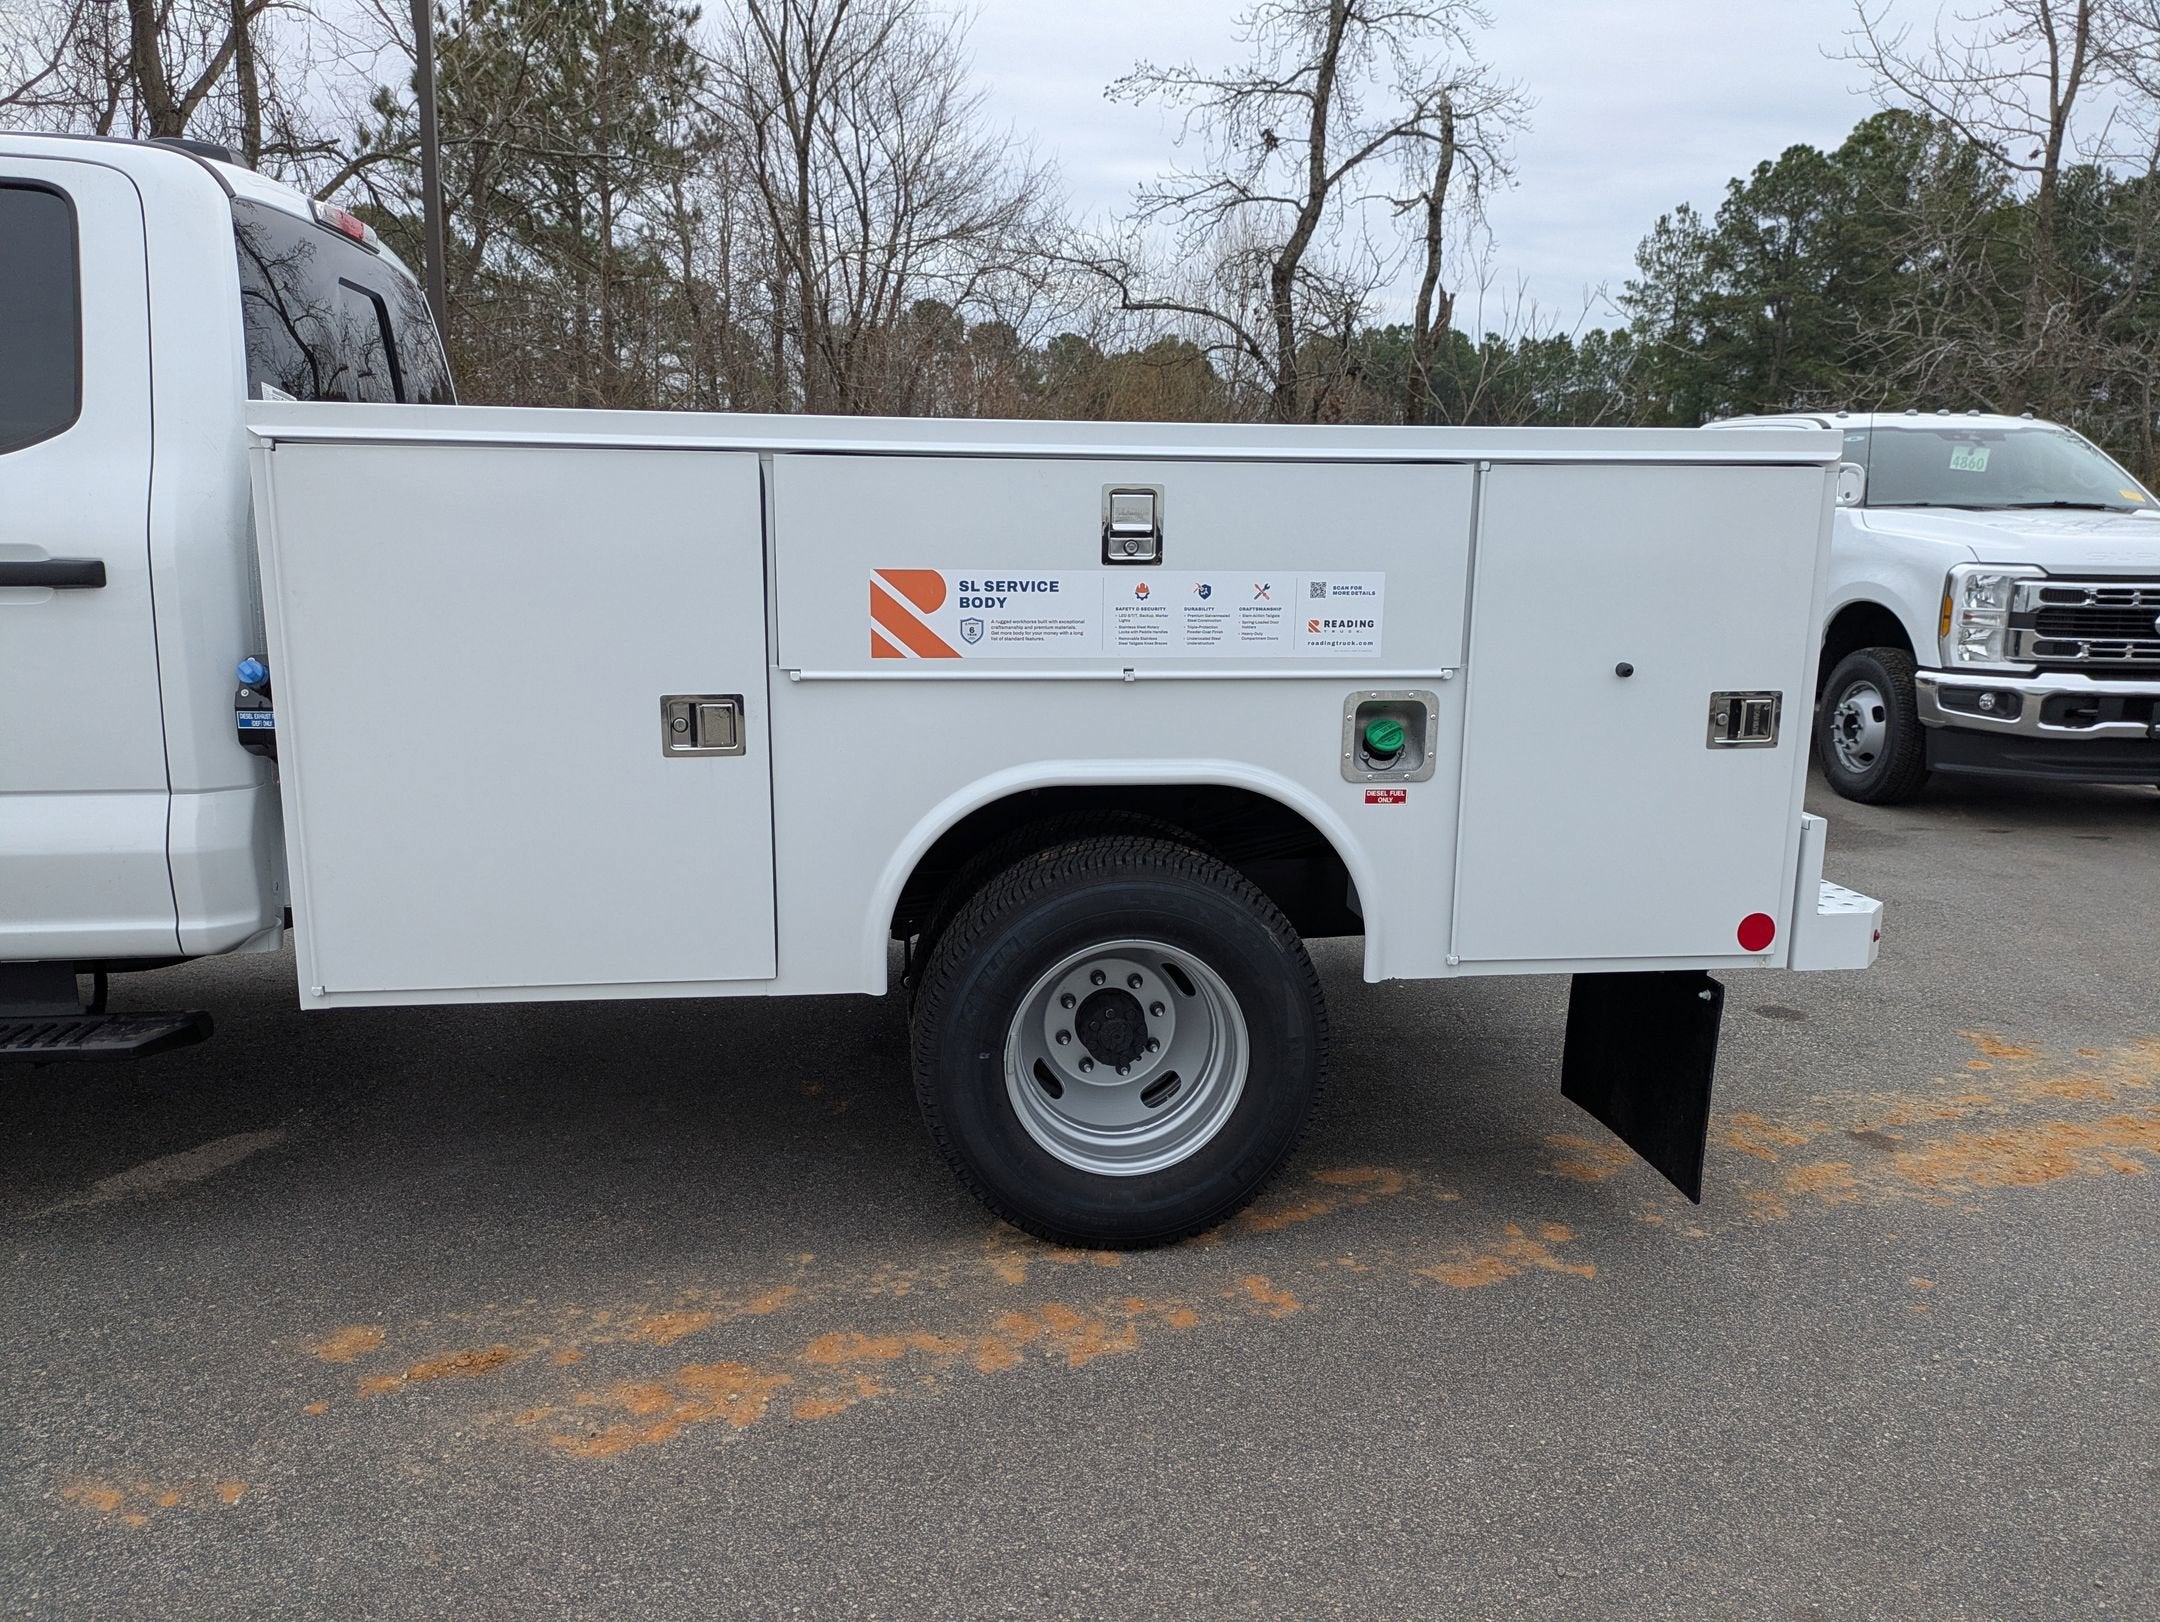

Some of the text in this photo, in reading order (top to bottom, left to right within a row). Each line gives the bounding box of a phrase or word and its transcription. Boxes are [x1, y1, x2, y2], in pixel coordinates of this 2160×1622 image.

[1952, 456, 1985, 470] 4860
[959, 580, 1060, 592] SL SERVICE
[959, 597, 1007, 608] BODY
[1324, 620, 1374, 628] READING
